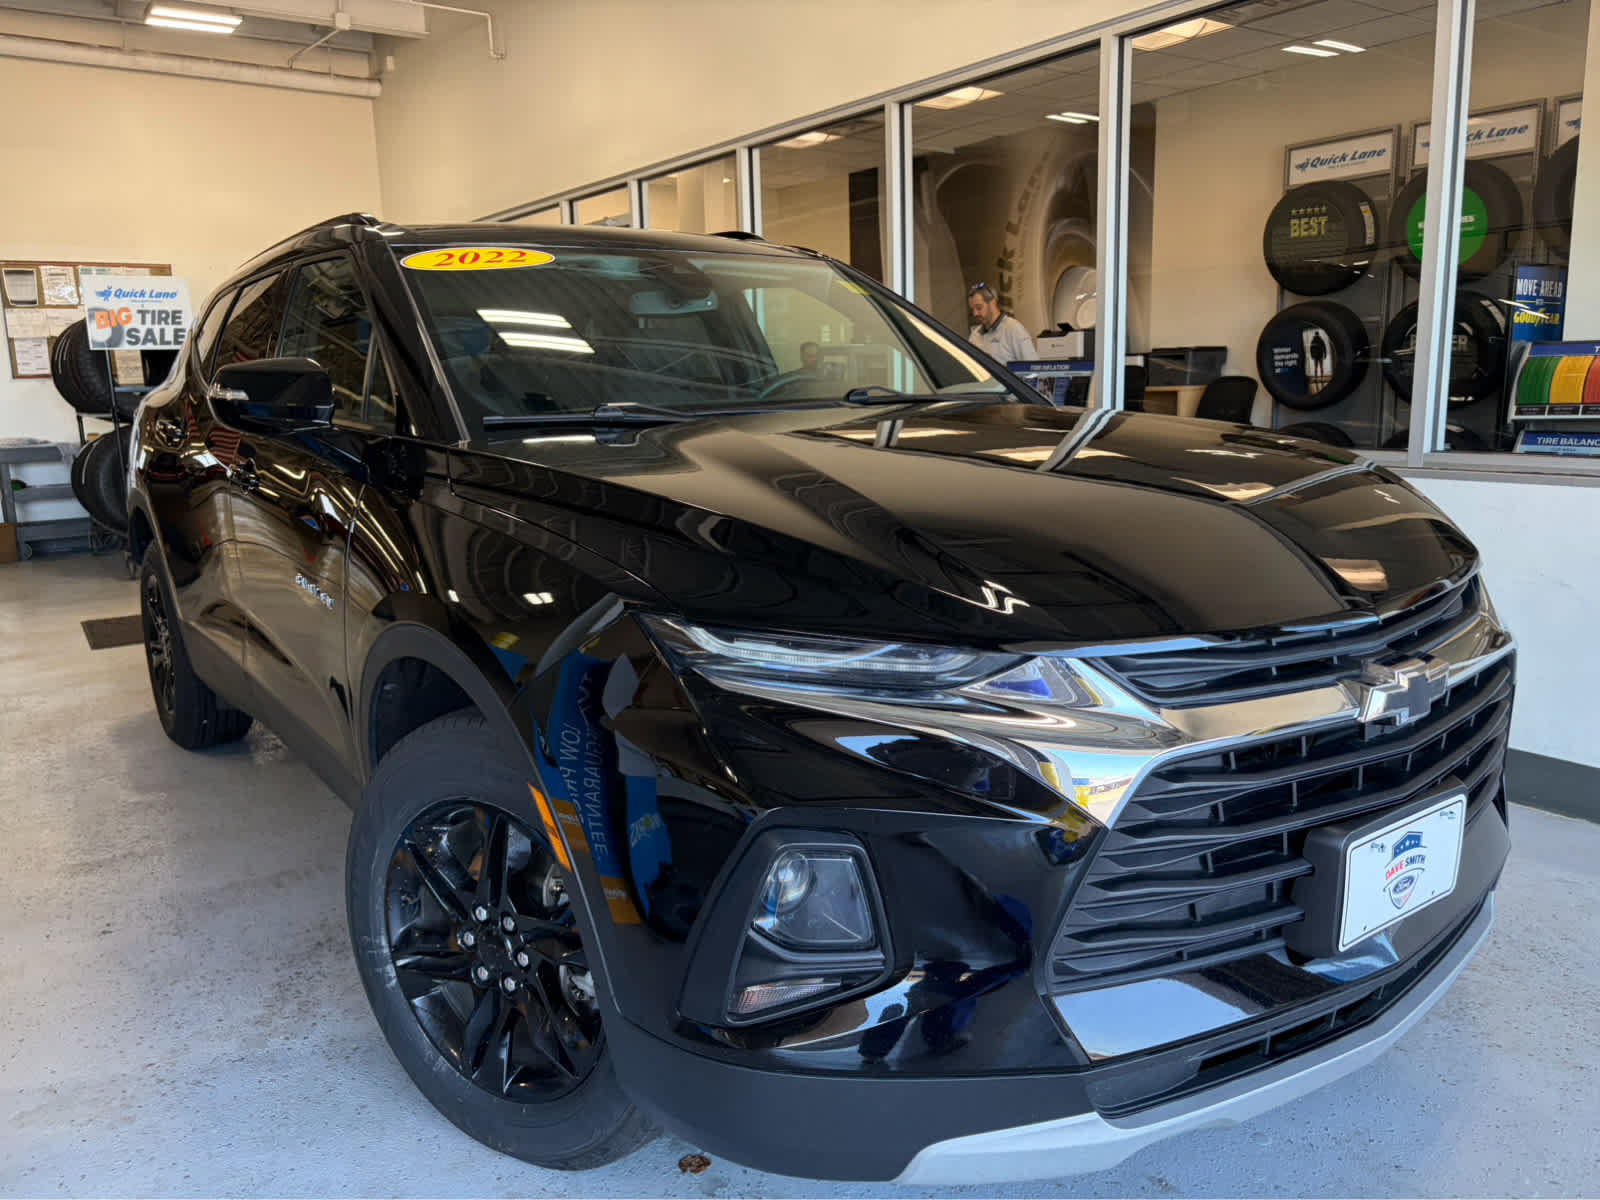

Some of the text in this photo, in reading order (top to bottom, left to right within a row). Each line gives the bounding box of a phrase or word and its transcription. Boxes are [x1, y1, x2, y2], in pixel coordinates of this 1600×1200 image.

[1487, 124, 1529, 138] Lane
[1310, 152, 1349, 168] Quick
[1350, 148, 1386, 161] Lane
[1290, 216, 1328, 238] BEST
[433, 251, 527, 267] 2022
[114, 288, 178, 300] Quick Lane
[1516, 278, 1562, 298] MOVE AHEAD
[95, 307, 133, 330] BIG
[137, 310, 183, 325] TIRE
[126, 328, 187, 346] SALE
[1536, 436, 1558, 446] TIRE
[1385, 854, 1426, 880] DAVE SMITH
